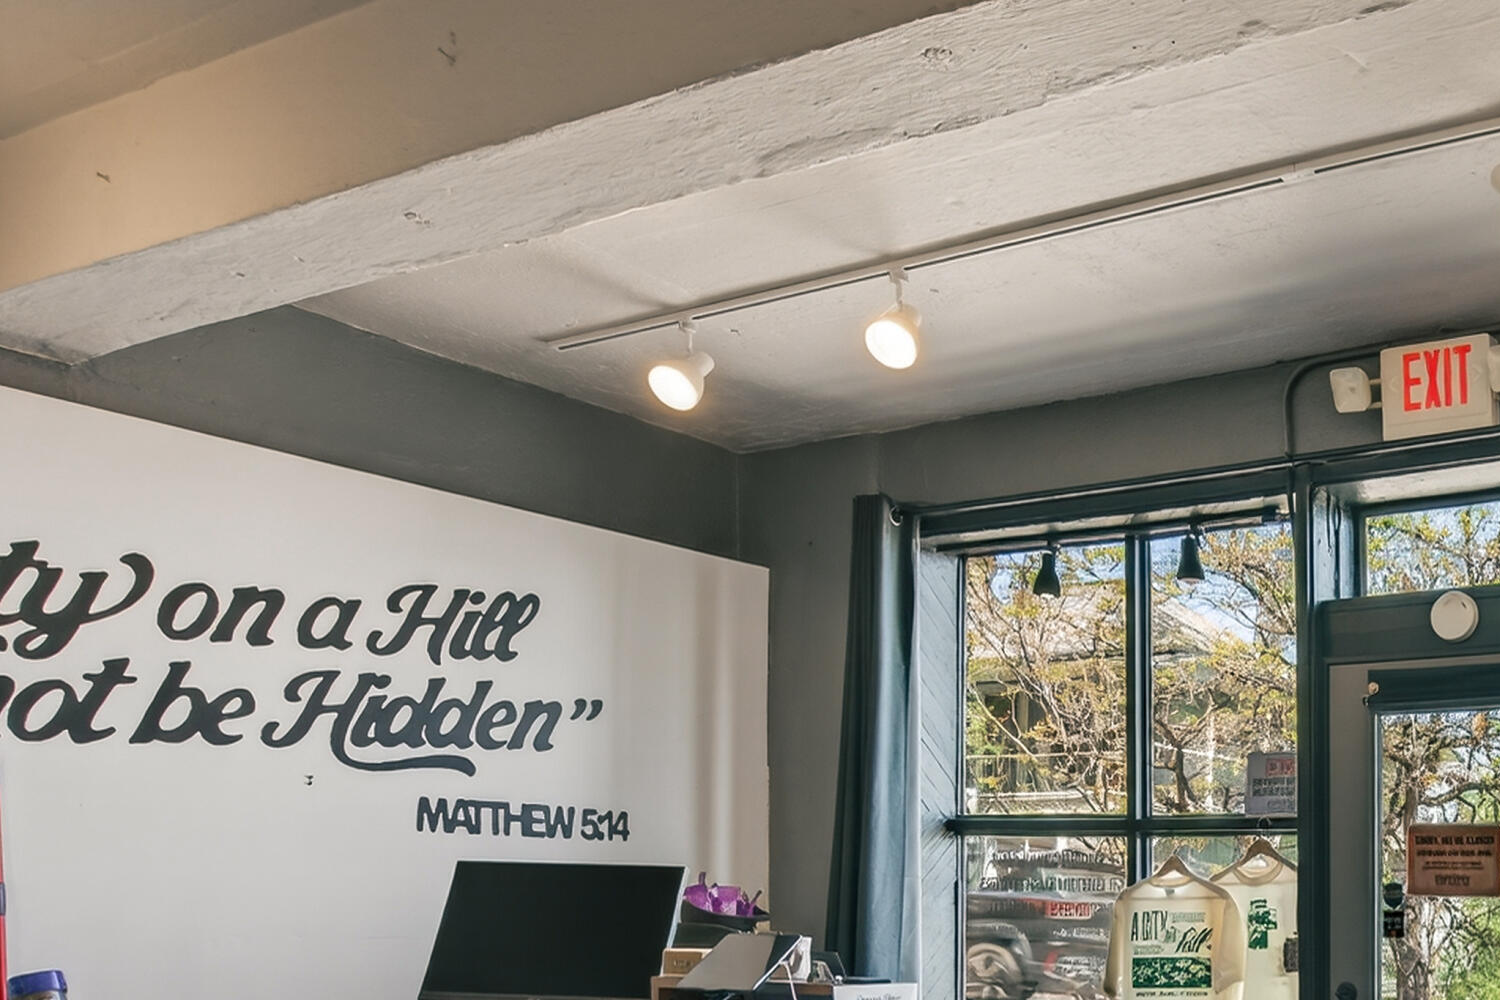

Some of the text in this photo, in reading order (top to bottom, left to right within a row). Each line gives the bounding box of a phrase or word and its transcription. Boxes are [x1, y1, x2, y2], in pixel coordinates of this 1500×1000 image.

[1403, 344, 1472, 412] EXIT
[156, 581, 287, 647] on
[296, 595, 363, 651] a
[366, 583, 541, 665] Hill
[128, 660, 257, 746] be
[416, 796, 631, 842] MATTHEW 5:14
[1131, 911, 1139, 942] A
